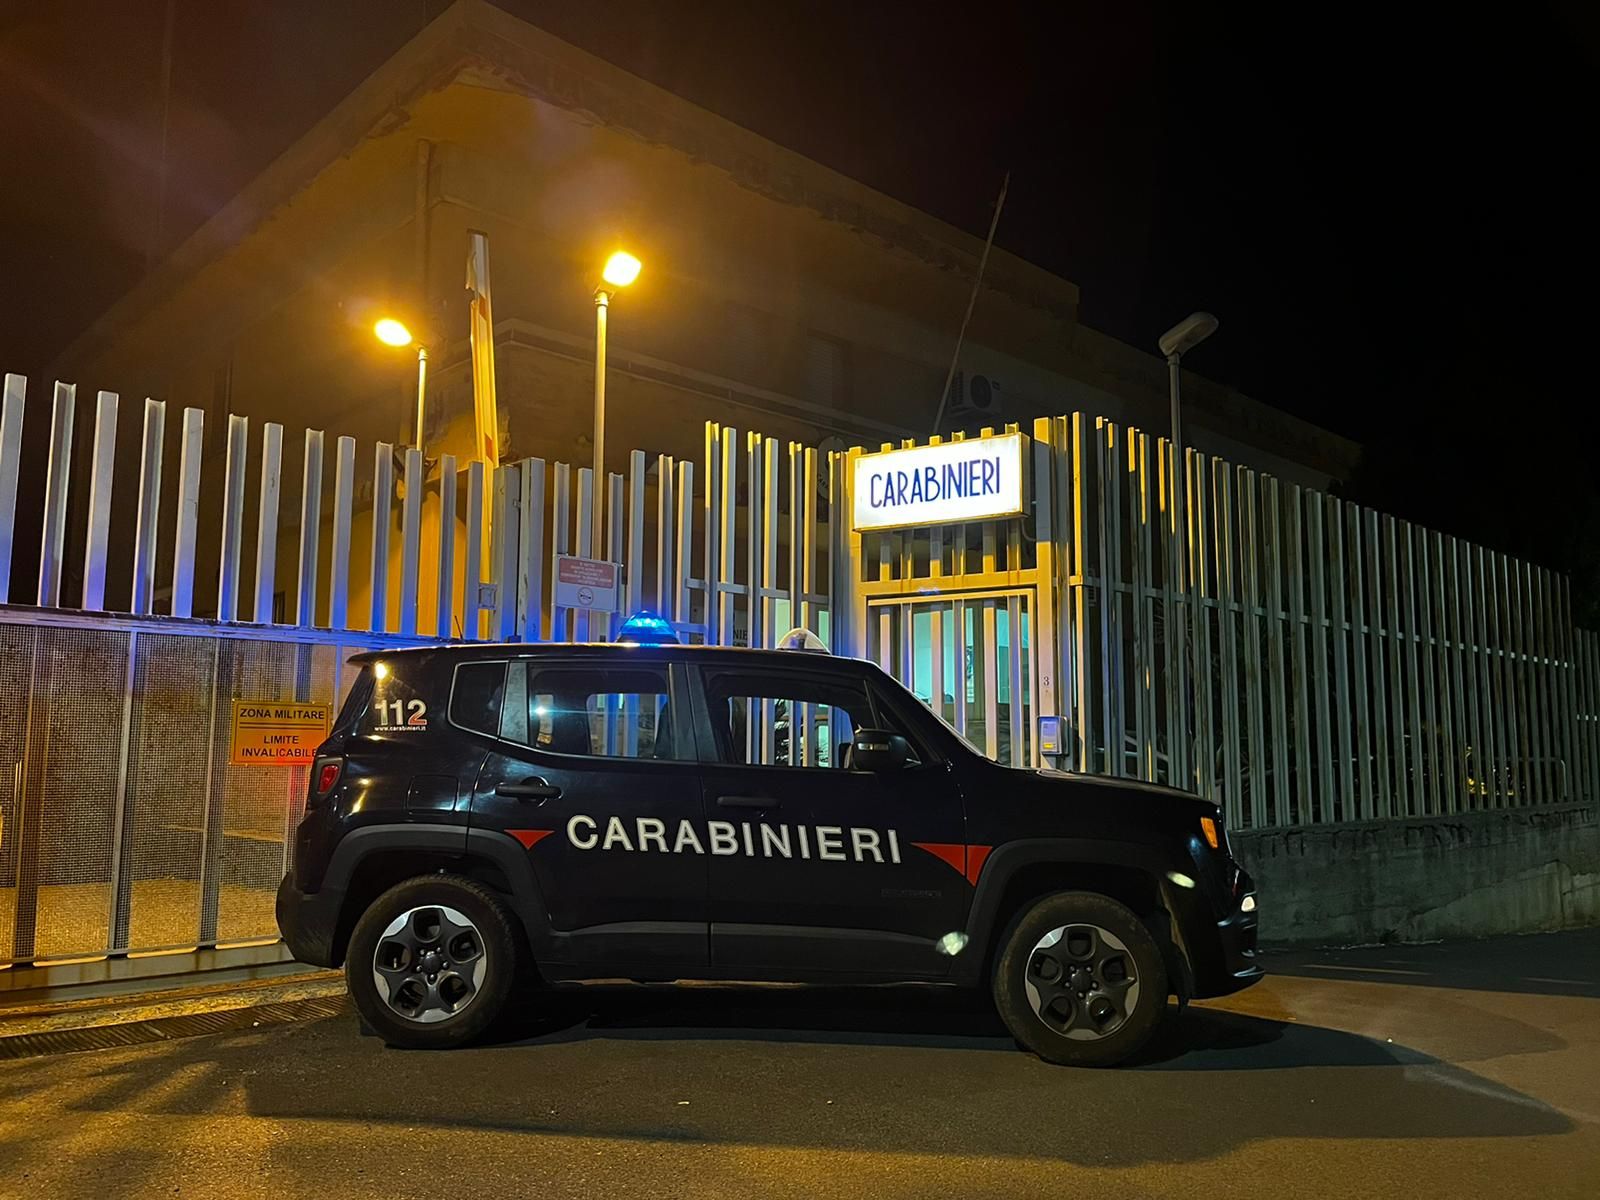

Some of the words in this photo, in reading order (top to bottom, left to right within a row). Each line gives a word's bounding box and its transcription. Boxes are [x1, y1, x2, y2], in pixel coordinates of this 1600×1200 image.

[870, 456, 1000, 508] CARABINIERI
[1043, 676, 1050, 686] 3
[240, 708, 271, 718] ZONA
[275, 709, 325, 720] MILITARE
[374, 699, 428, 726] 112
[263, 735, 299, 744] LIMITE
[566, 814, 902, 864] CARABINIERI
